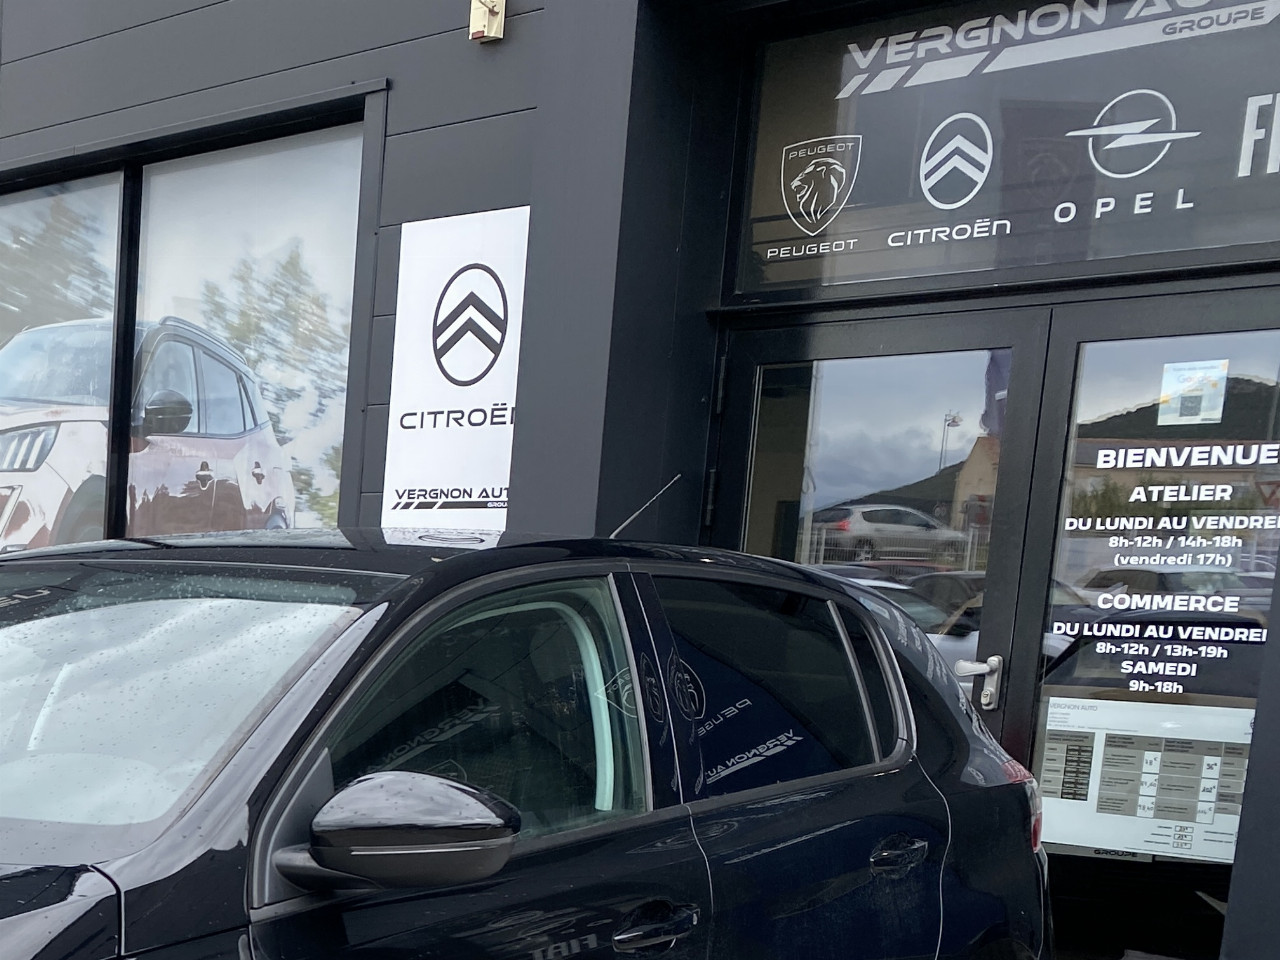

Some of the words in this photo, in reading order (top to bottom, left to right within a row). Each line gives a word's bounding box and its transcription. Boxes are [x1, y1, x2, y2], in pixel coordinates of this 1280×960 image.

[1162, 6, 1266, 36] GROUPE
[847, 0, 1108, 69] VERGNON
[788, 142, 855, 160] PEUGEOT
[1053, 188, 1195, 223] OPEL
[766, 238, 859, 260] PEUGEOT
[399, 403, 514, 430] CITROË
[1096, 443, 1280, 469] BIENVENUE
[395, 488, 473, 500] VERGNON
[1128, 484, 1233, 503] ATELIER
[1064, 517, 1093, 531] DU
[1095, 516, 1154, 531] LUNDI
[1157, 516, 1187, 530] AU
[1108, 536, 1163, 548] 8h-12h
[1177, 535, 1243, 548] 14h-18h
[1113, 553, 1193, 567] (vendredi
[1196, 553, 1233, 567] 17h)
[1097, 593, 1241, 613] COMMERCE
[1052, 622, 1080, 636] DU
[1083, 623, 1140, 638] LUNDI
[1144, 625, 1174, 639] AU
[1095, 642, 1149, 656] 8h-12h
[1163, 644, 1228, 659] 13h-19h
[1120, 660, 1197, 677] SAMEDI
[1129, 680, 1183, 694] 9h-18h
